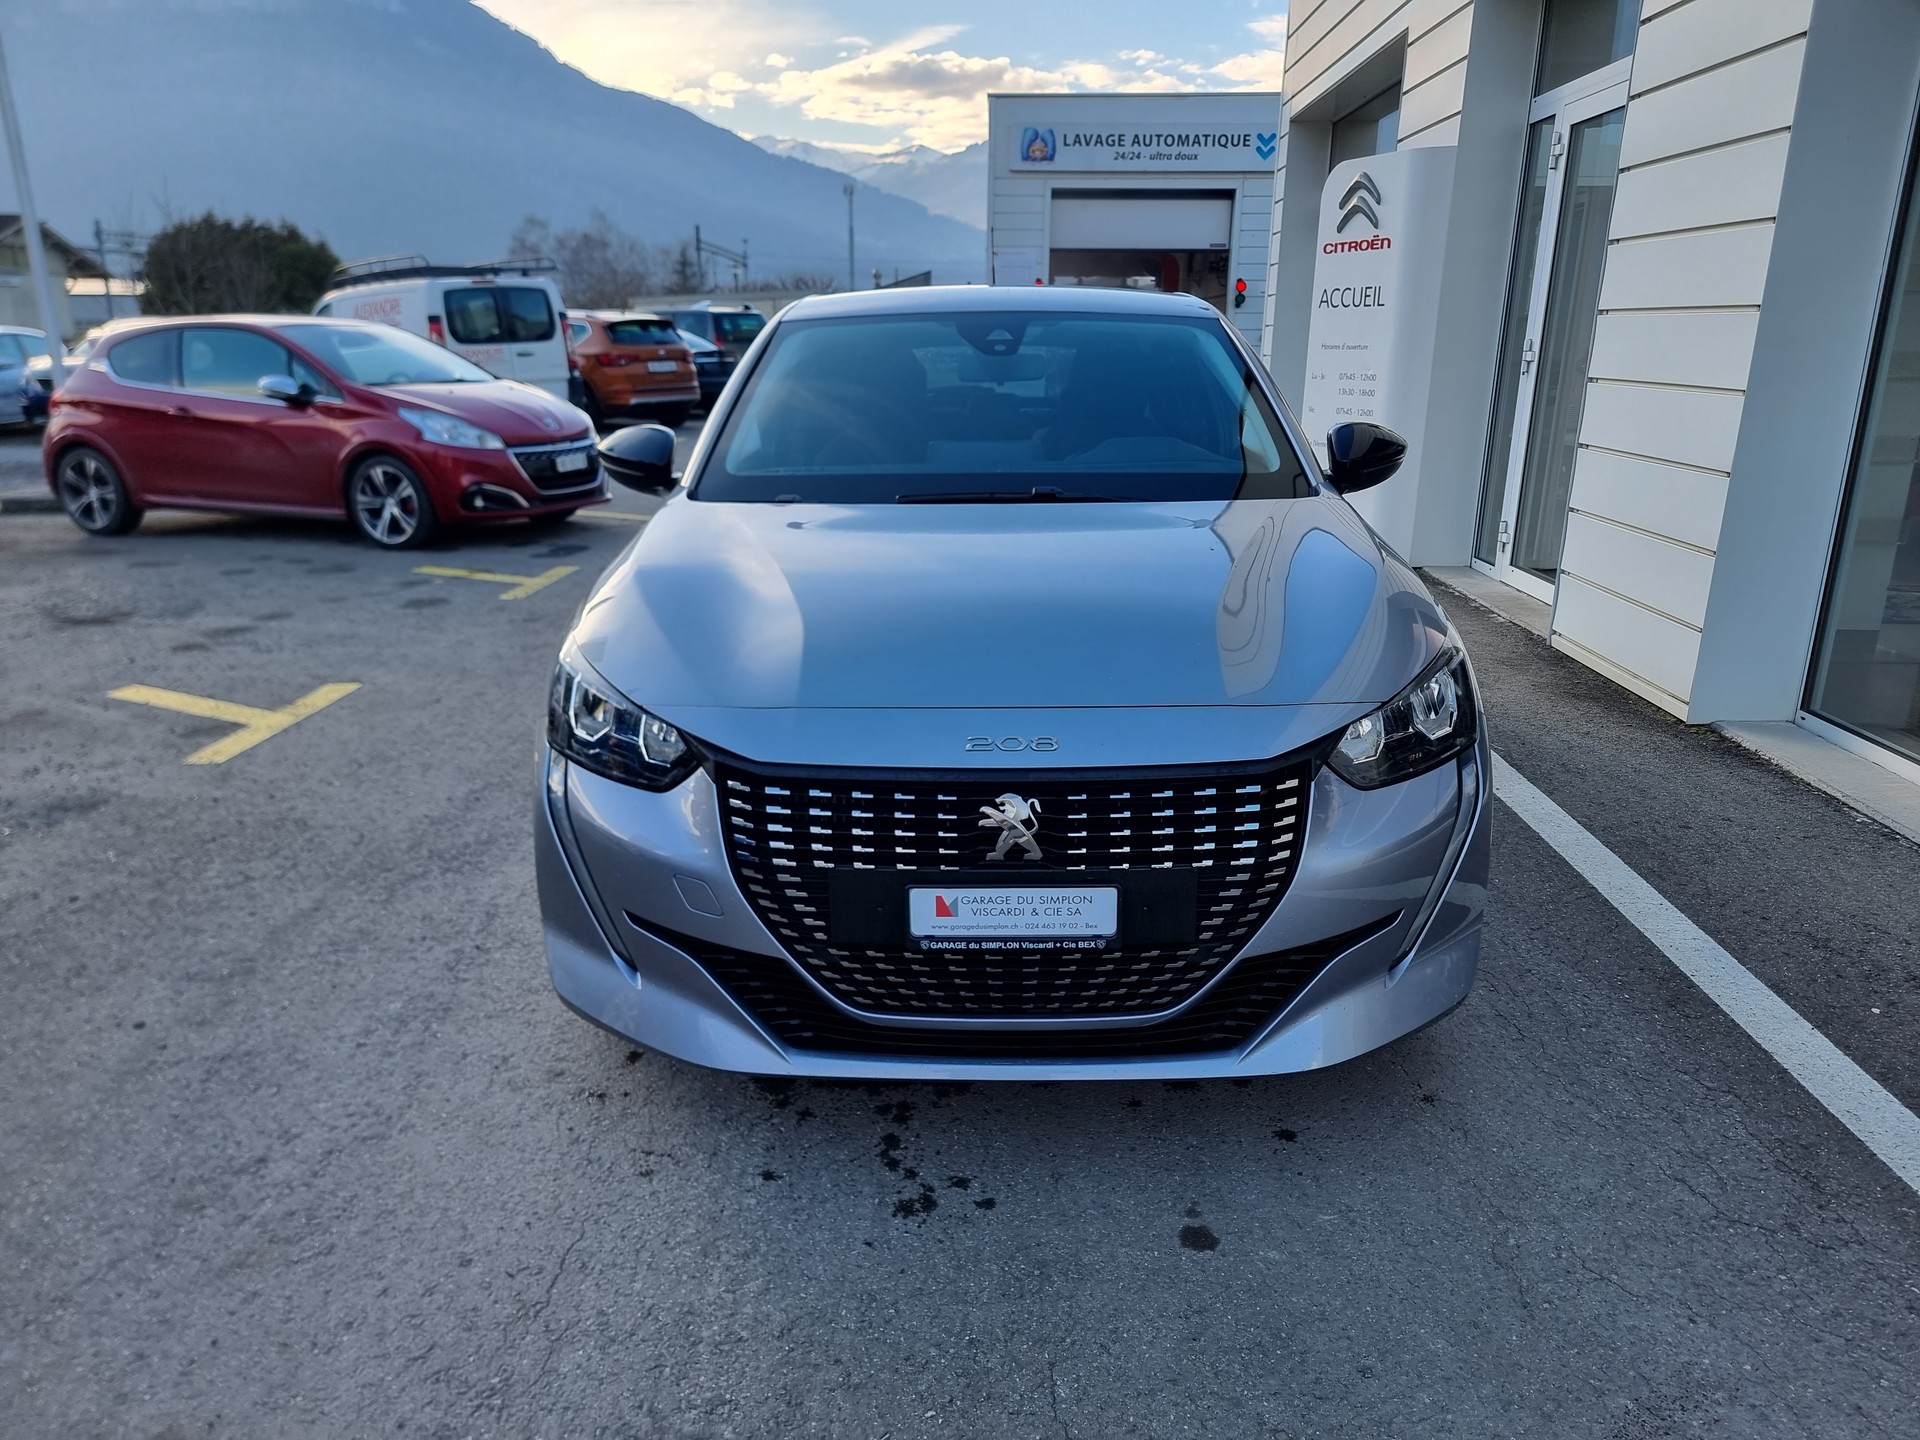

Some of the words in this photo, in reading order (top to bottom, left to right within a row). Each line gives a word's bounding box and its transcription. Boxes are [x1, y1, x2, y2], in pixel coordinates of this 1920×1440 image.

[1063, 133, 1126, 147] LAVAGE
[1131, 133, 1251, 149] AUTOMATIQUE
[1114, 152, 1141, 160] 24/24
[1149, 151, 1173, 160] ultra
[1174, 151, 1199, 160] doux
[1319, 286, 1385, 308] ACCUEIL
[1320, 342, 1340, 350] Horaires
[1338, 372, 1356, 381] 07h45
[1360, 373, 1377, 382] 12h00
[965, 735, 1059, 752] 208
[961, 896, 1011, 905] GARAGE
[1017, 896, 1034, 905] DU
[1039, 896, 1093, 905] SIMPLON
[971, 907, 1025, 916] VISCARDI
[1031, 907, 1039, 916] &
[1044, 907, 1063, 916] CIE
[1067, 907, 1082, 916] SA
[931, 923, 1019, 931] www.garagedusimplon.ch
[1025, 922, 1040, 930] 024
[1041, 922, 1056, 930] 463
[1059, 922, 1067, 930] 19
[1069, 922, 1079, 930] 02
[1085, 922, 1098, 930] Bex
[1021, 941, 1054, 949] Viscardi
[1063, 941, 1077, 949] Cie
[1078, 941, 1096, 949] BEX
